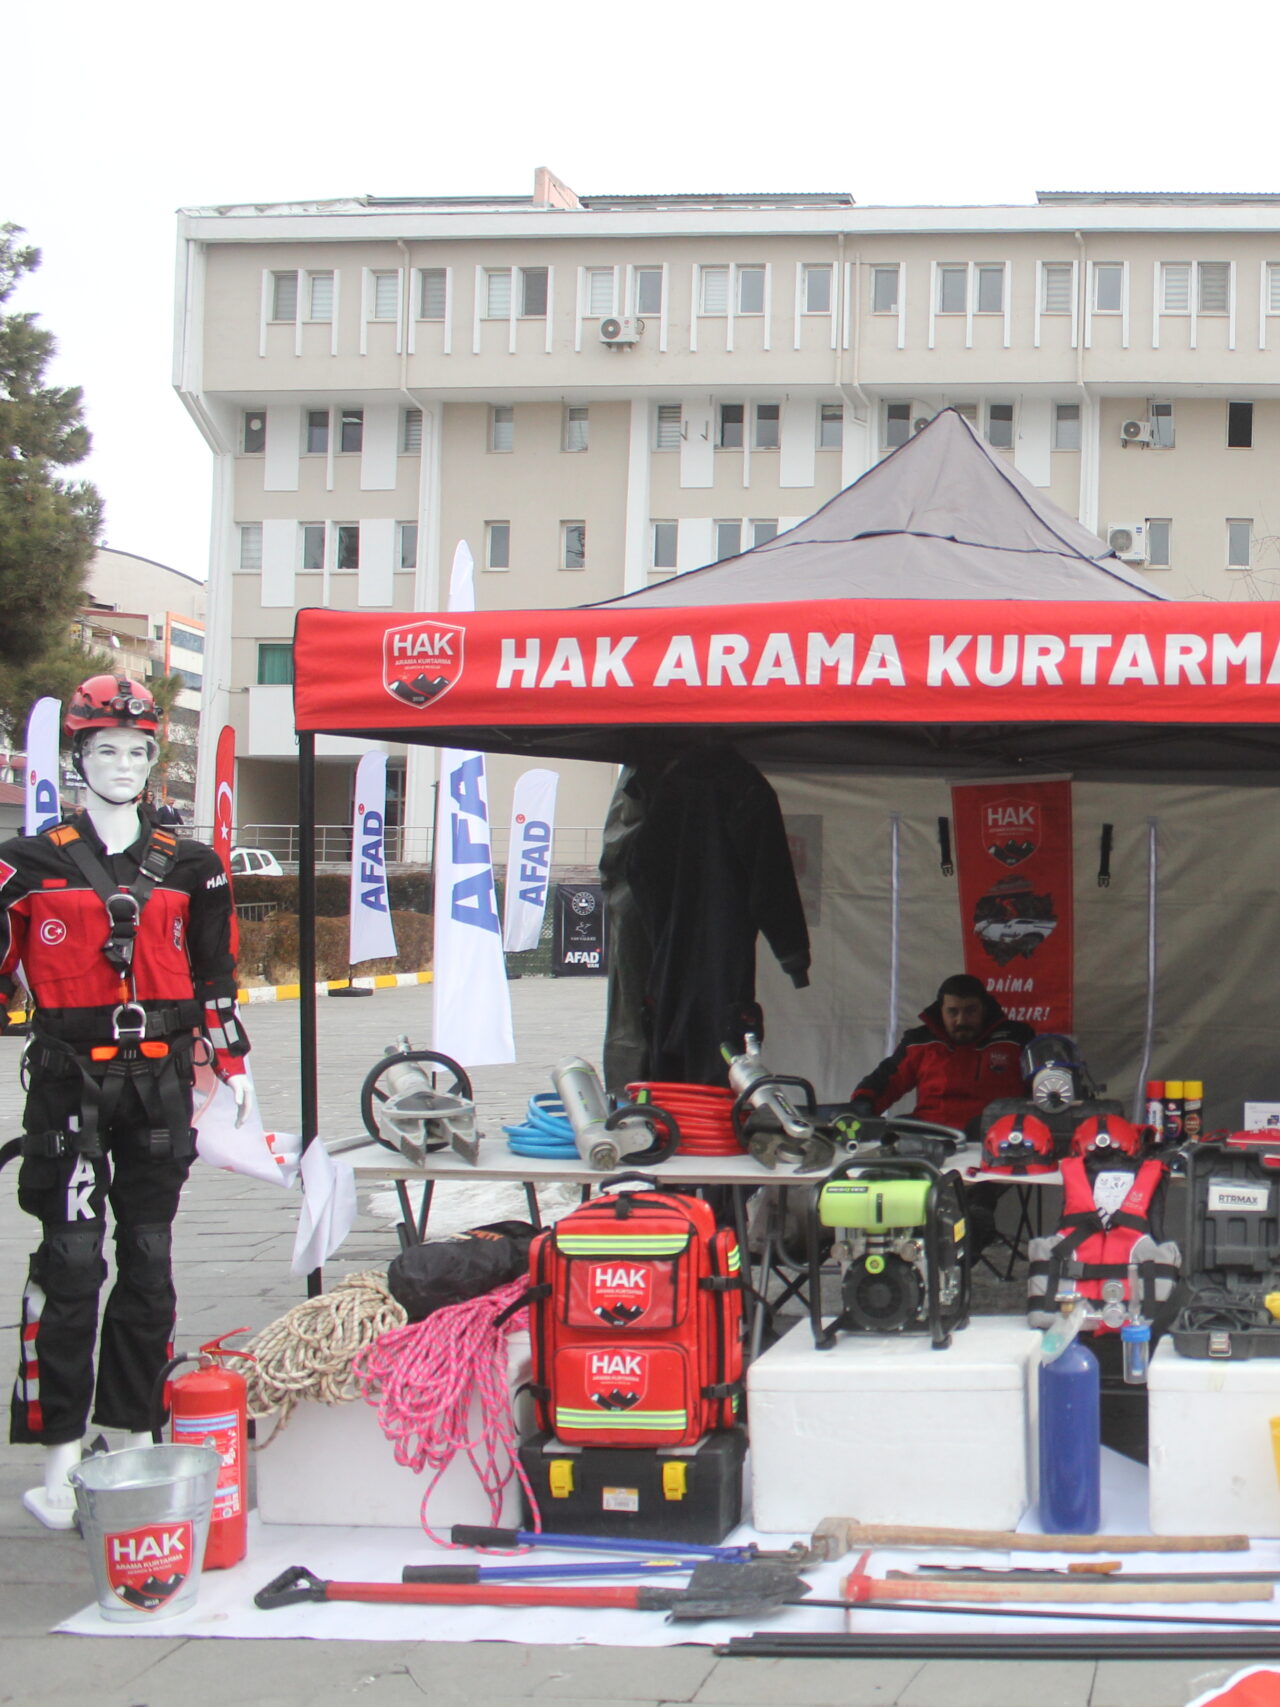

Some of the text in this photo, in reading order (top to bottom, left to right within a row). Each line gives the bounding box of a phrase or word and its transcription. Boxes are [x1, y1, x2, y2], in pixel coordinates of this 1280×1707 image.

[393, 632, 454, 657] HAK
[496, 636, 638, 689] HAK
[652, 632, 906, 687] ARAMA
[987, 806, 1035, 826] HAK
[450, 754, 501, 935] AFA
[361, 810, 388, 913] AFAD
[518, 820, 550, 908] AFAD
[564, 951, 600, 964] AFAD
[986, 975, 1034, 992] DAİMA
[1218, 1194, 1258, 1205] RTRMAX
[594, 1268, 647, 1289] HAK
[591, 1354, 642, 1375] HAK
[113, 1527, 186, 1562] HAK
